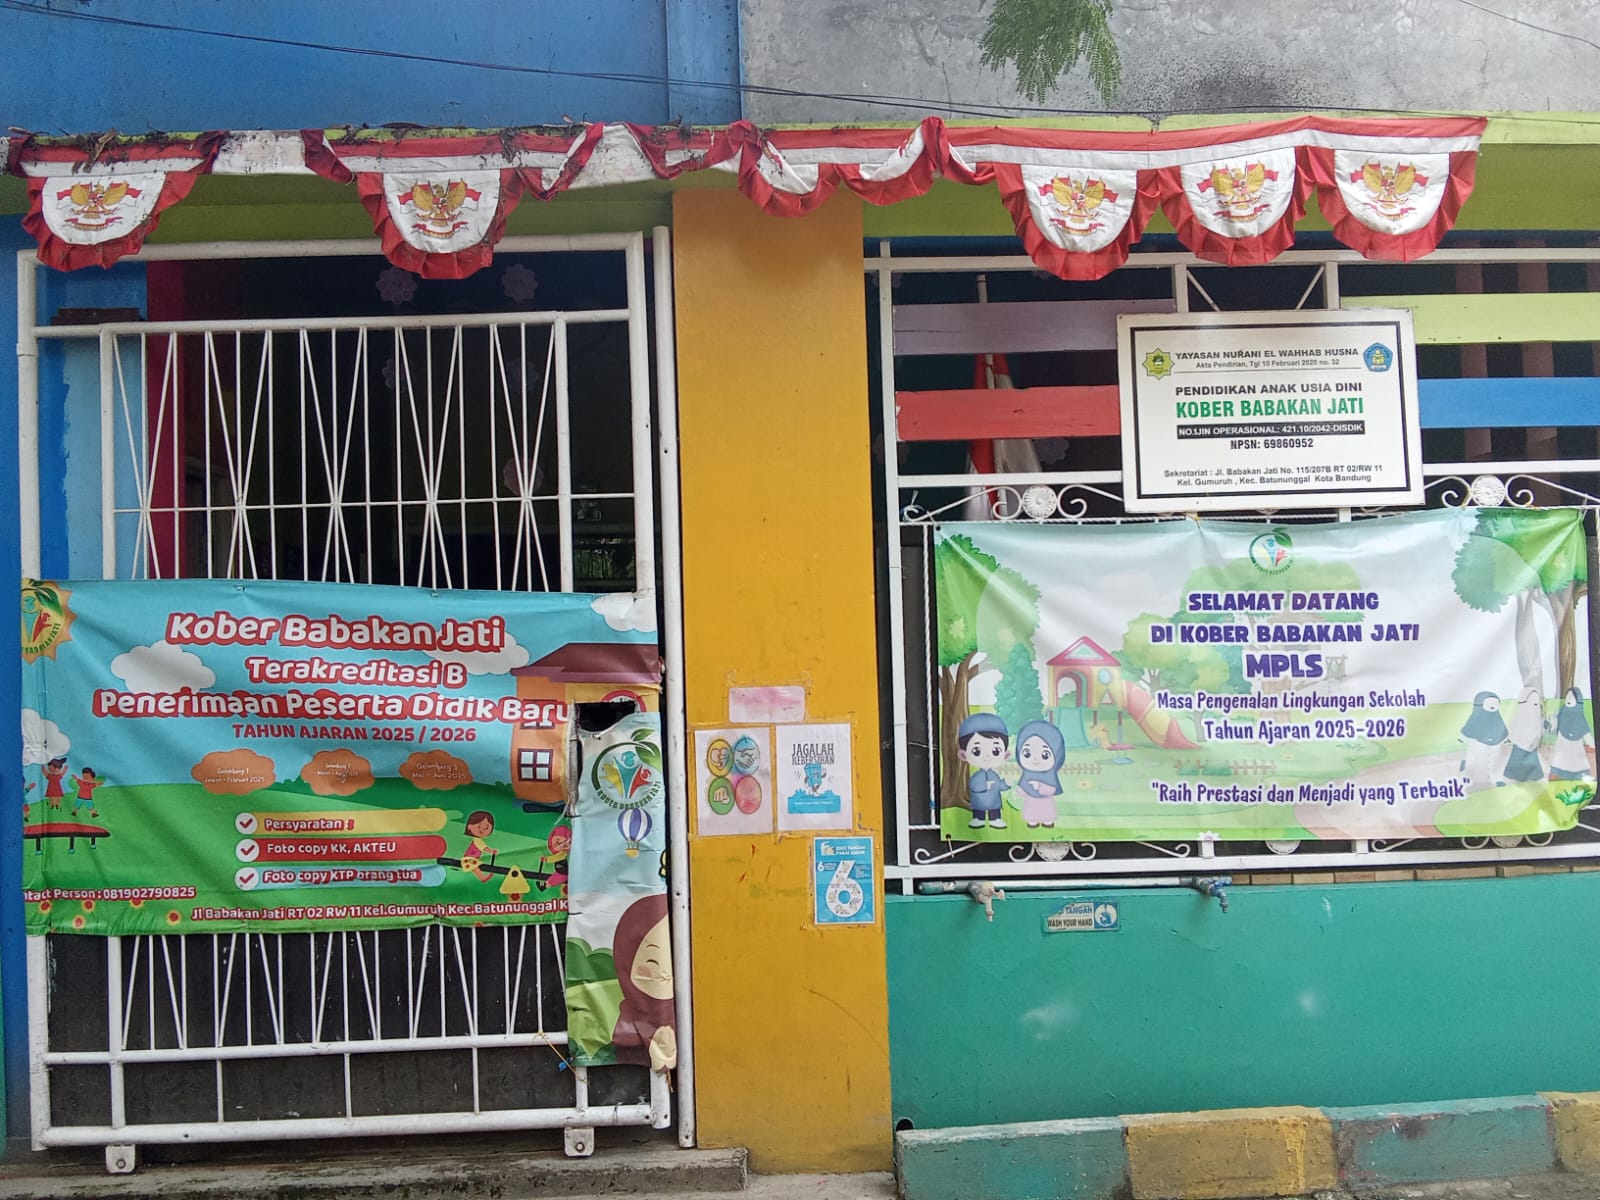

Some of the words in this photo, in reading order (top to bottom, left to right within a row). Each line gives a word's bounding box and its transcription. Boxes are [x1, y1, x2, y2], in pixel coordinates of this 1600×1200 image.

[1175, 351, 1220, 360] YAYASAN
[1223, 349, 1261, 359] NURANI
[1264, 350, 1276, 358] EL
[1279, 348, 1322, 358] WAHHAB
[1324, 348, 1359, 356] HUSNA
[1249, 360, 1260, 368] Tgl
[1176, 385, 1256, 396] PENDIDIKAN
[1260, 384, 1297, 394] ANAK
[1300, 383, 1332, 393] USIA
[1336, 382, 1362, 392] DINI
[1176, 400, 1234, 418] KOBER
[1240, 398, 1322, 416] BABAKAN
[1327, 398, 1364, 414] JATI
[1212, 426, 1280, 435] OPERASIONAL:
[1282, 424, 1364, 433] 421.10/2042-DISDIK
[1230, 439, 1261, 449] NPSN:
[1264, 438, 1314, 448] 69860952
[1164, 469, 1208, 477] Sekretariat
[1226, 467, 1261, 476] Babakan
[1347, 464, 1372, 472] 02/RW
[1194, 478, 1232, 486] Gumuruh
[1259, 475, 1310, 484] Batununggal
[1336, 474, 1372, 482] Bandung
[1188, 593, 1284, 611] SELAMAT
[1292, 592, 1379, 611] DATANG
[168, 612, 278, 642] Kober
[282, 615, 433, 647] Babakan
[440, 617, 502, 649] Jati
[1151, 625, 1173, 643] DI
[1180, 625, 1249, 643] KOBER
[1257, 624, 1362, 642] BABAKAN
[1370, 624, 1420, 642] JATI
[248, 658, 439, 686] Terakreditasi
[445, 664, 465, 686] B
[1246, 654, 1324, 678] MPLS
[98, 690, 280, 715] Penerimaan
[284, 692, 404, 718] Peserta
[411, 694, 495, 720] Didik
[501, 699, 569, 723] Baru
[1157, 692, 1192, 709] Masa
[1197, 691, 1278, 714] Pengenalan
[1282, 690, 1365, 713] Lingkungan
[1369, 688, 1426, 708] Sekolah
[232, 724, 296, 738] TAHUN
[300, 724, 368, 740] AJARAN
[371, 726, 414, 742] 2025
[418, 726, 427, 744] /
[430, 727, 477, 742] 2026
[1204, 720, 1254, 740] Tahun
[1258, 720, 1310, 744] Ajaran
[1315, 718, 1405, 738] 2025-2026
[792, 743, 834, 756] JAGALAH
[792, 755, 834, 766] KEBERSIHAN
[1152, 782, 1192, 802] "Raih
[1198, 784, 1262, 802] Prestasi
[1266, 784, 1294, 802] dan
[1299, 782, 1354, 806] Menjadi
[1359, 788, 1395, 805] yang
[1399, 778, 1470, 800] Terbaik"
[264, 818, 342, 833] Persyaratan
[267, 843, 296, 854] Foto
[298, 844, 328, 856] copy
[330, 843, 350, 854] KK,
[353, 842, 396, 853] AKTEU
[264, 870, 296, 882] Foto
[298, 872, 327, 885] copy
[330, 870, 354, 881] KTP
[357, 871, 394, 882] orang
[396, 870, 417, 880] tua
[54, 888, 96, 899] Person
[103, 886, 195, 900] 081902790825
[192, 909, 202, 920] Jl
[205, 908, 260, 919] Babakan
[262, 908, 284, 919] Jati
[287, 908, 304, 918] RT
[307, 907, 323, 918] 02
[326, 906, 347, 918] RW
[349, 906, 361, 917] 11
[364, 905, 445, 916] Kel.Gumuruh
[448, 900, 557, 914] Kec.Batununggal
[1048, 919, 1062, 927] WASH
[1063, 919, 1076, 927] YOUR
